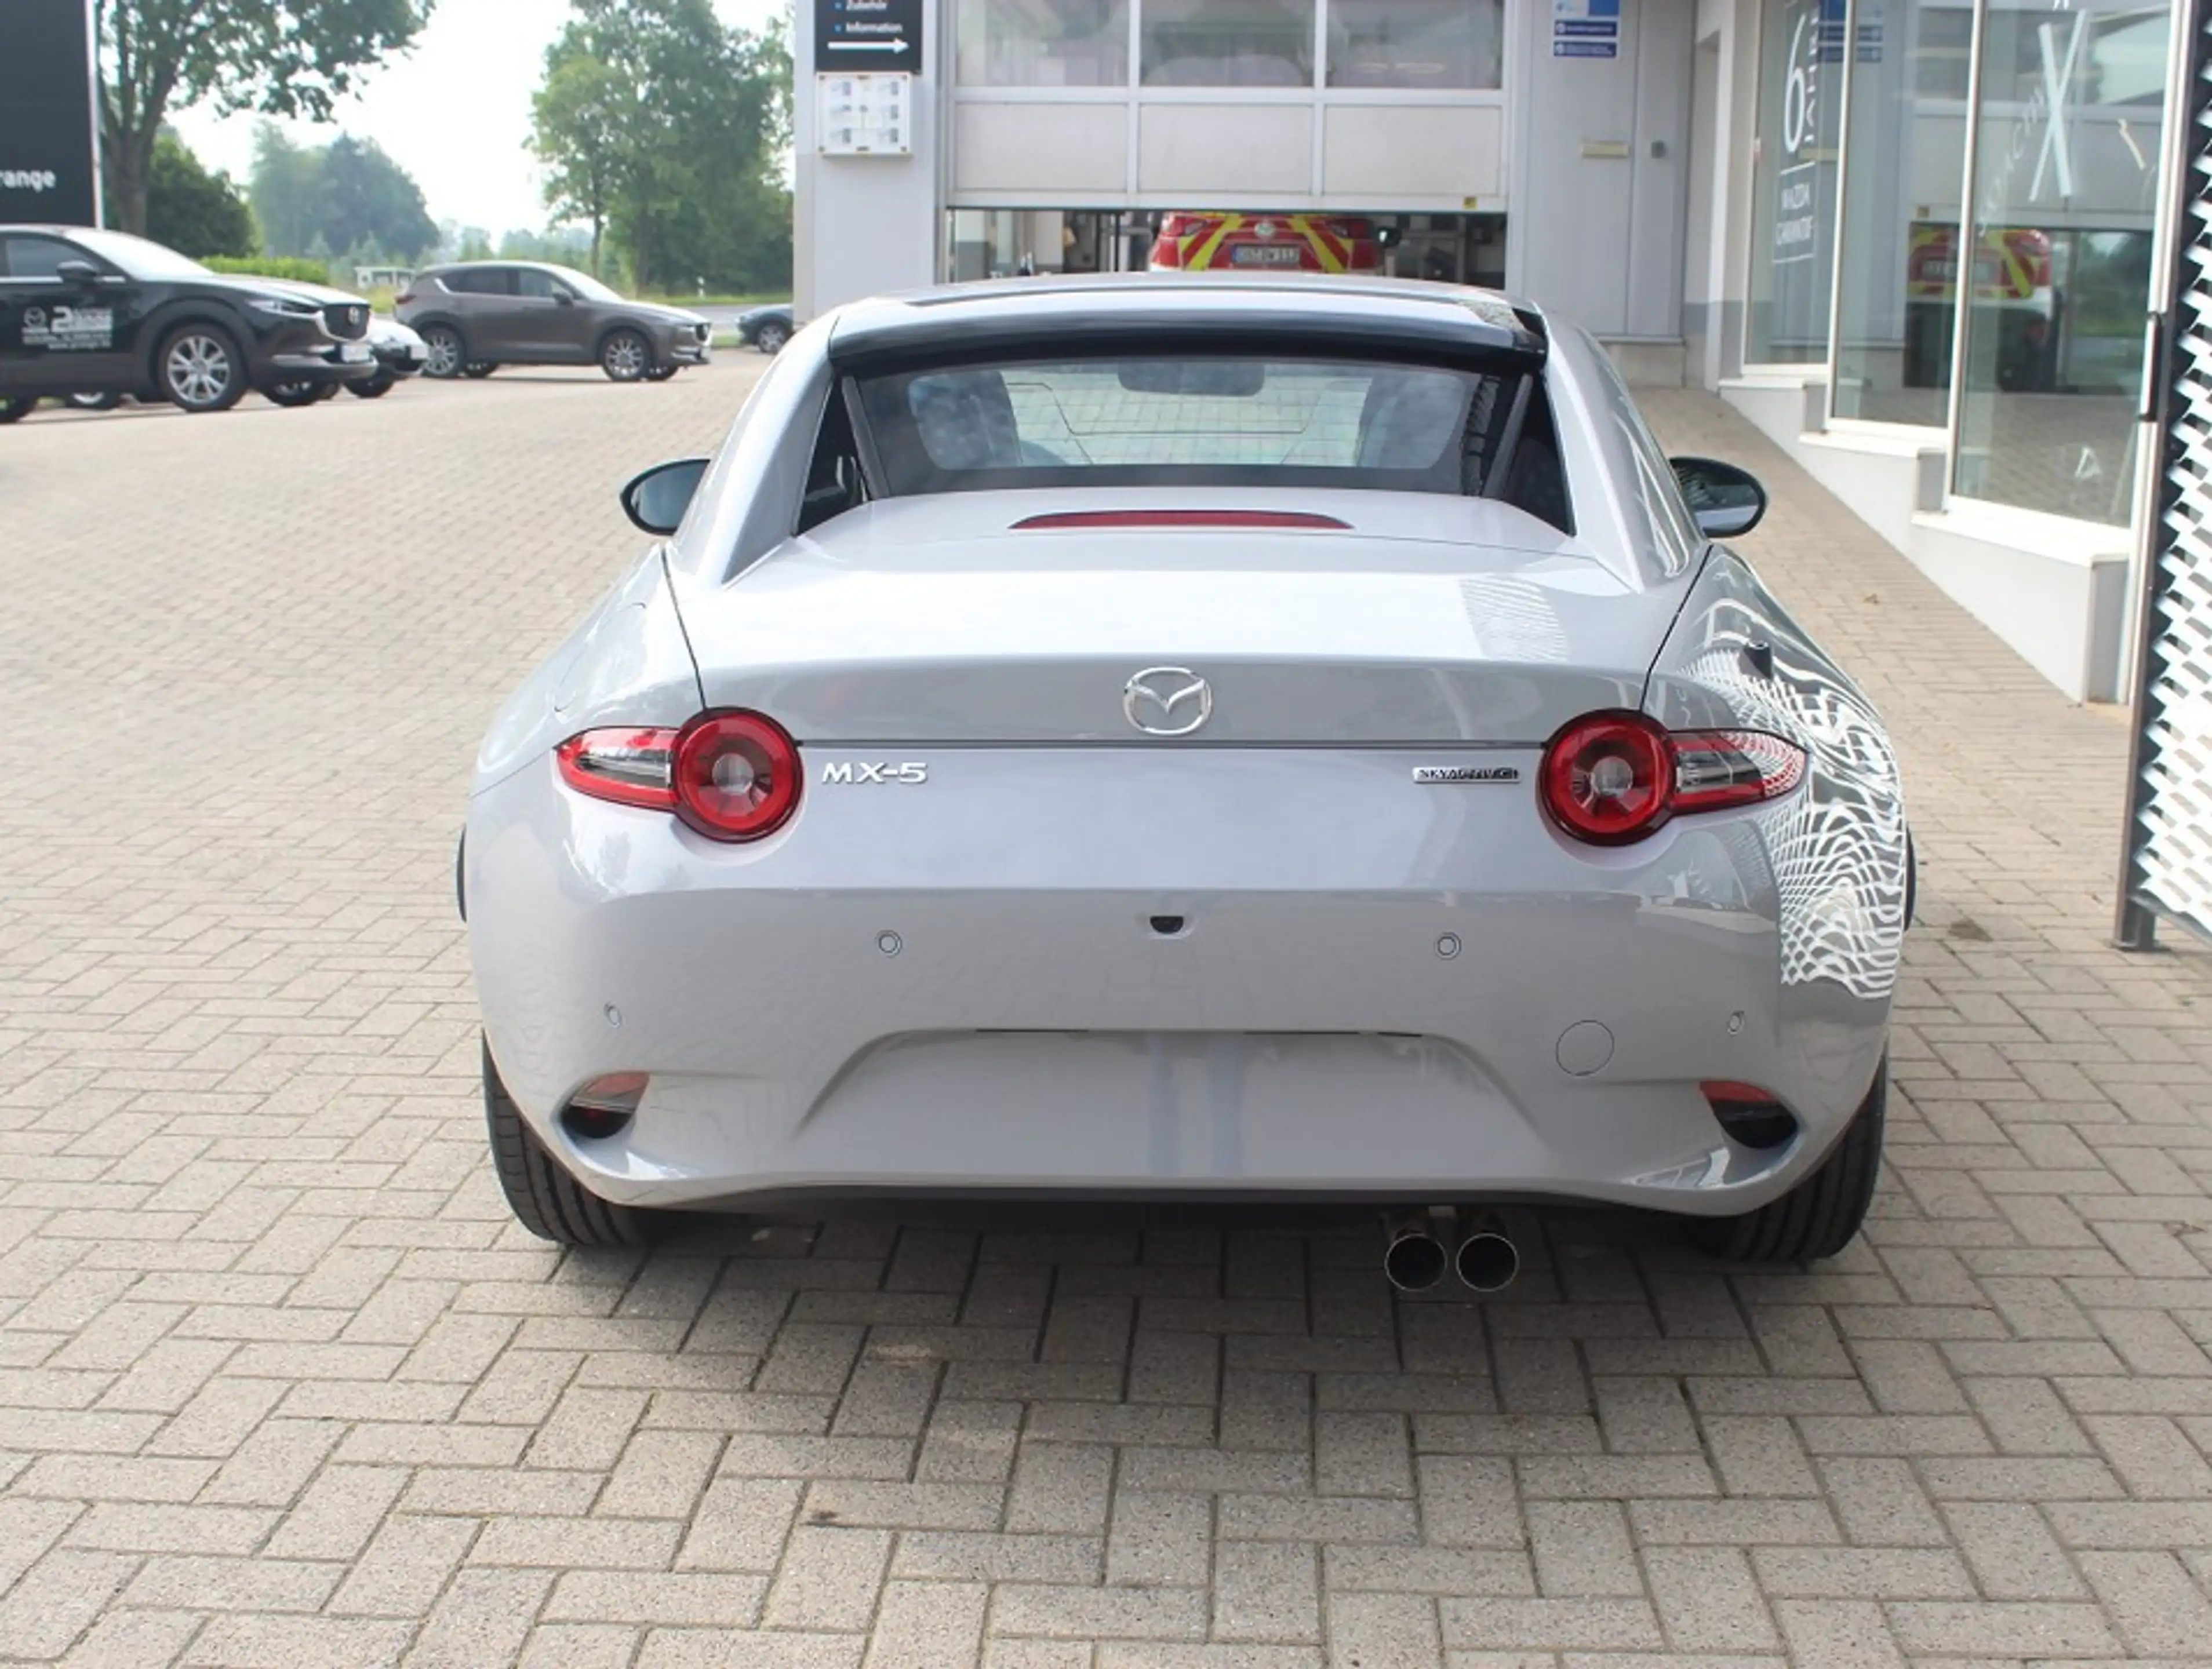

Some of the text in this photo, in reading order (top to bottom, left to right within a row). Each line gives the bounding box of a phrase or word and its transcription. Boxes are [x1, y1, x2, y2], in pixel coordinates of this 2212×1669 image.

[846, 21, 903, 34] Information
[1784, 13, 1806, 153] 6
[821, 761, 928, 784] MX-5
